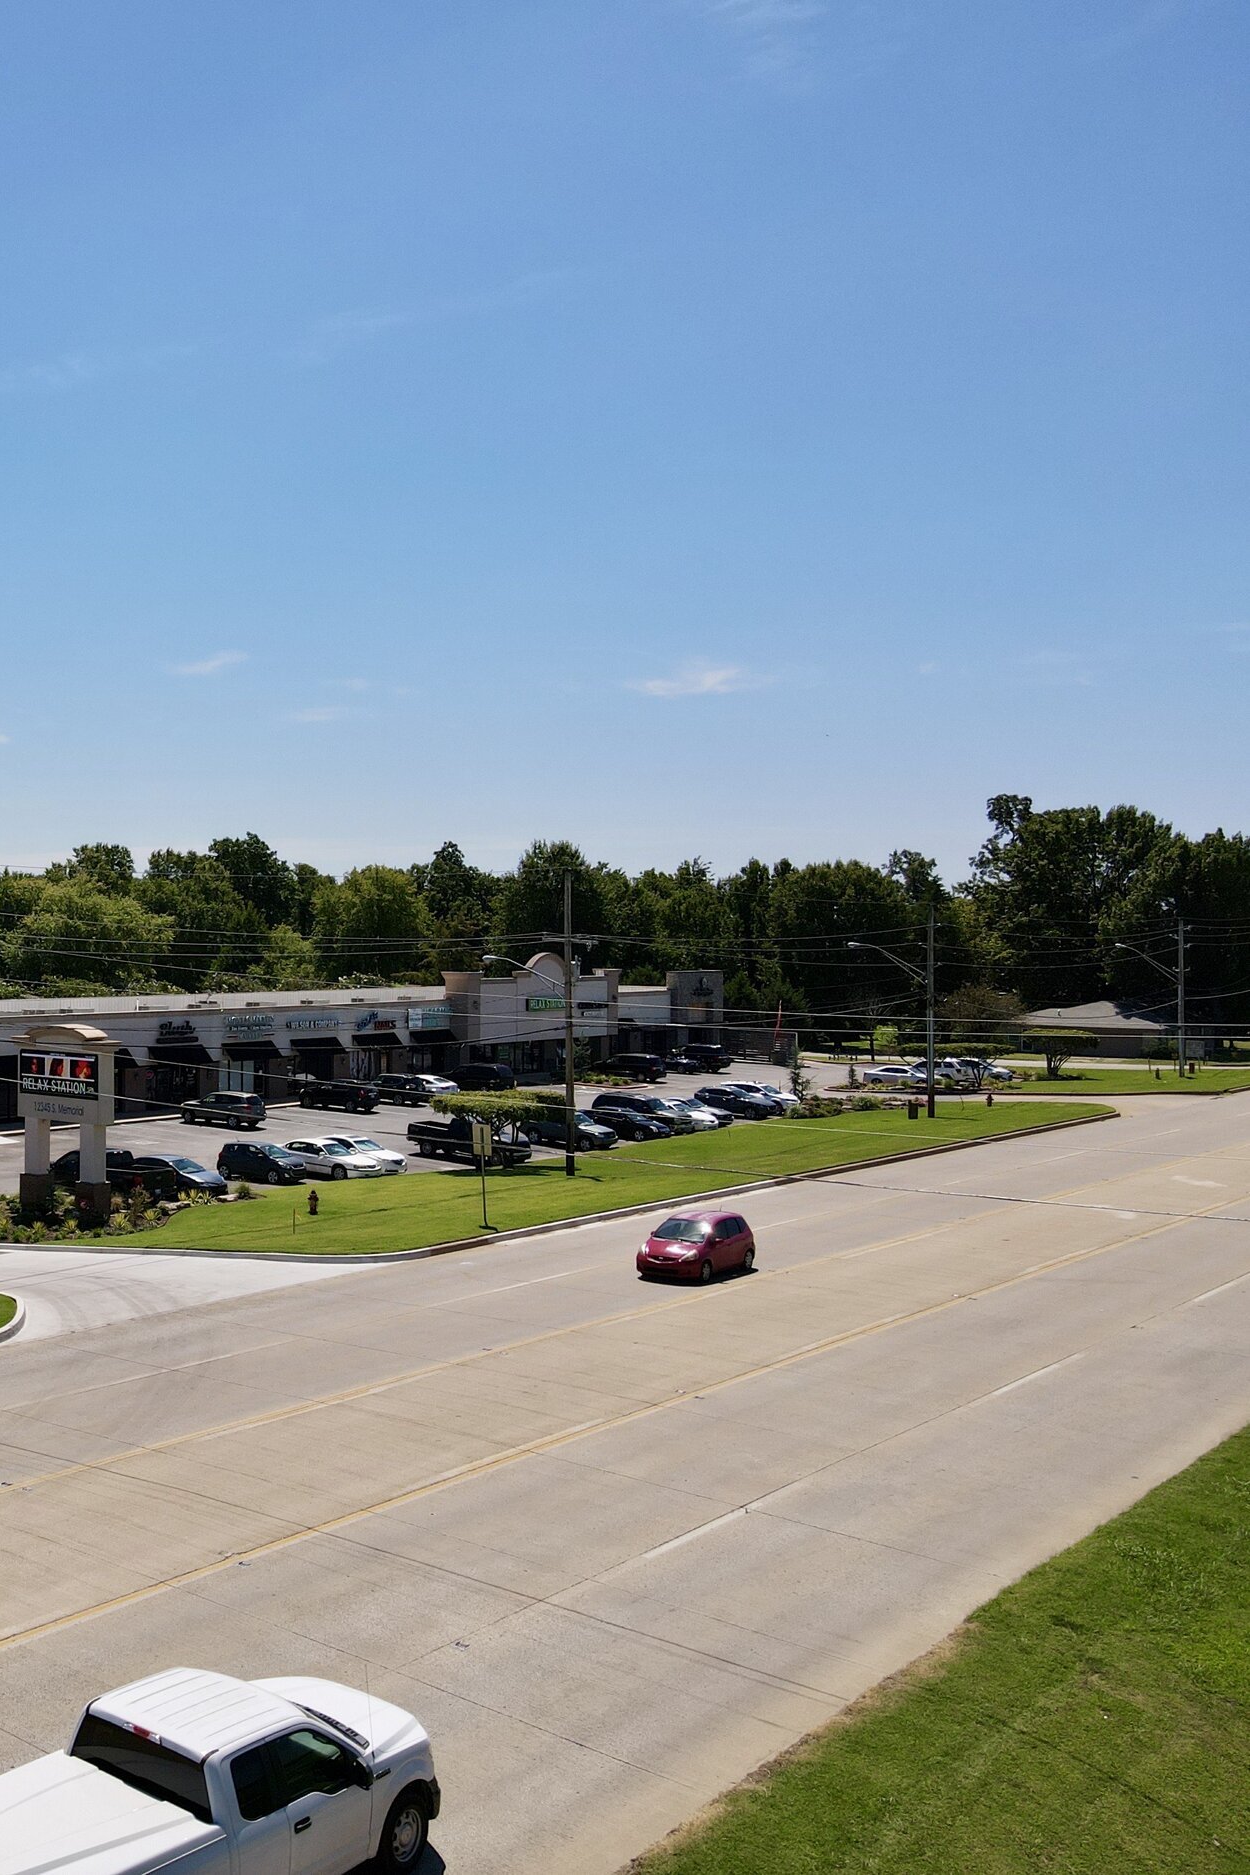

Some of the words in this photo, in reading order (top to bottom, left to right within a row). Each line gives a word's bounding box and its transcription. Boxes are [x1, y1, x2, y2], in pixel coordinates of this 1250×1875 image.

[530, 1000, 545, 1009] RELAX
[22, 1077, 49, 1091] RELAX
[51, 1079, 86, 1095] STATION
[34, 1101, 50, 1113] 12345
[58, 1104, 84, 1116] Memorial
